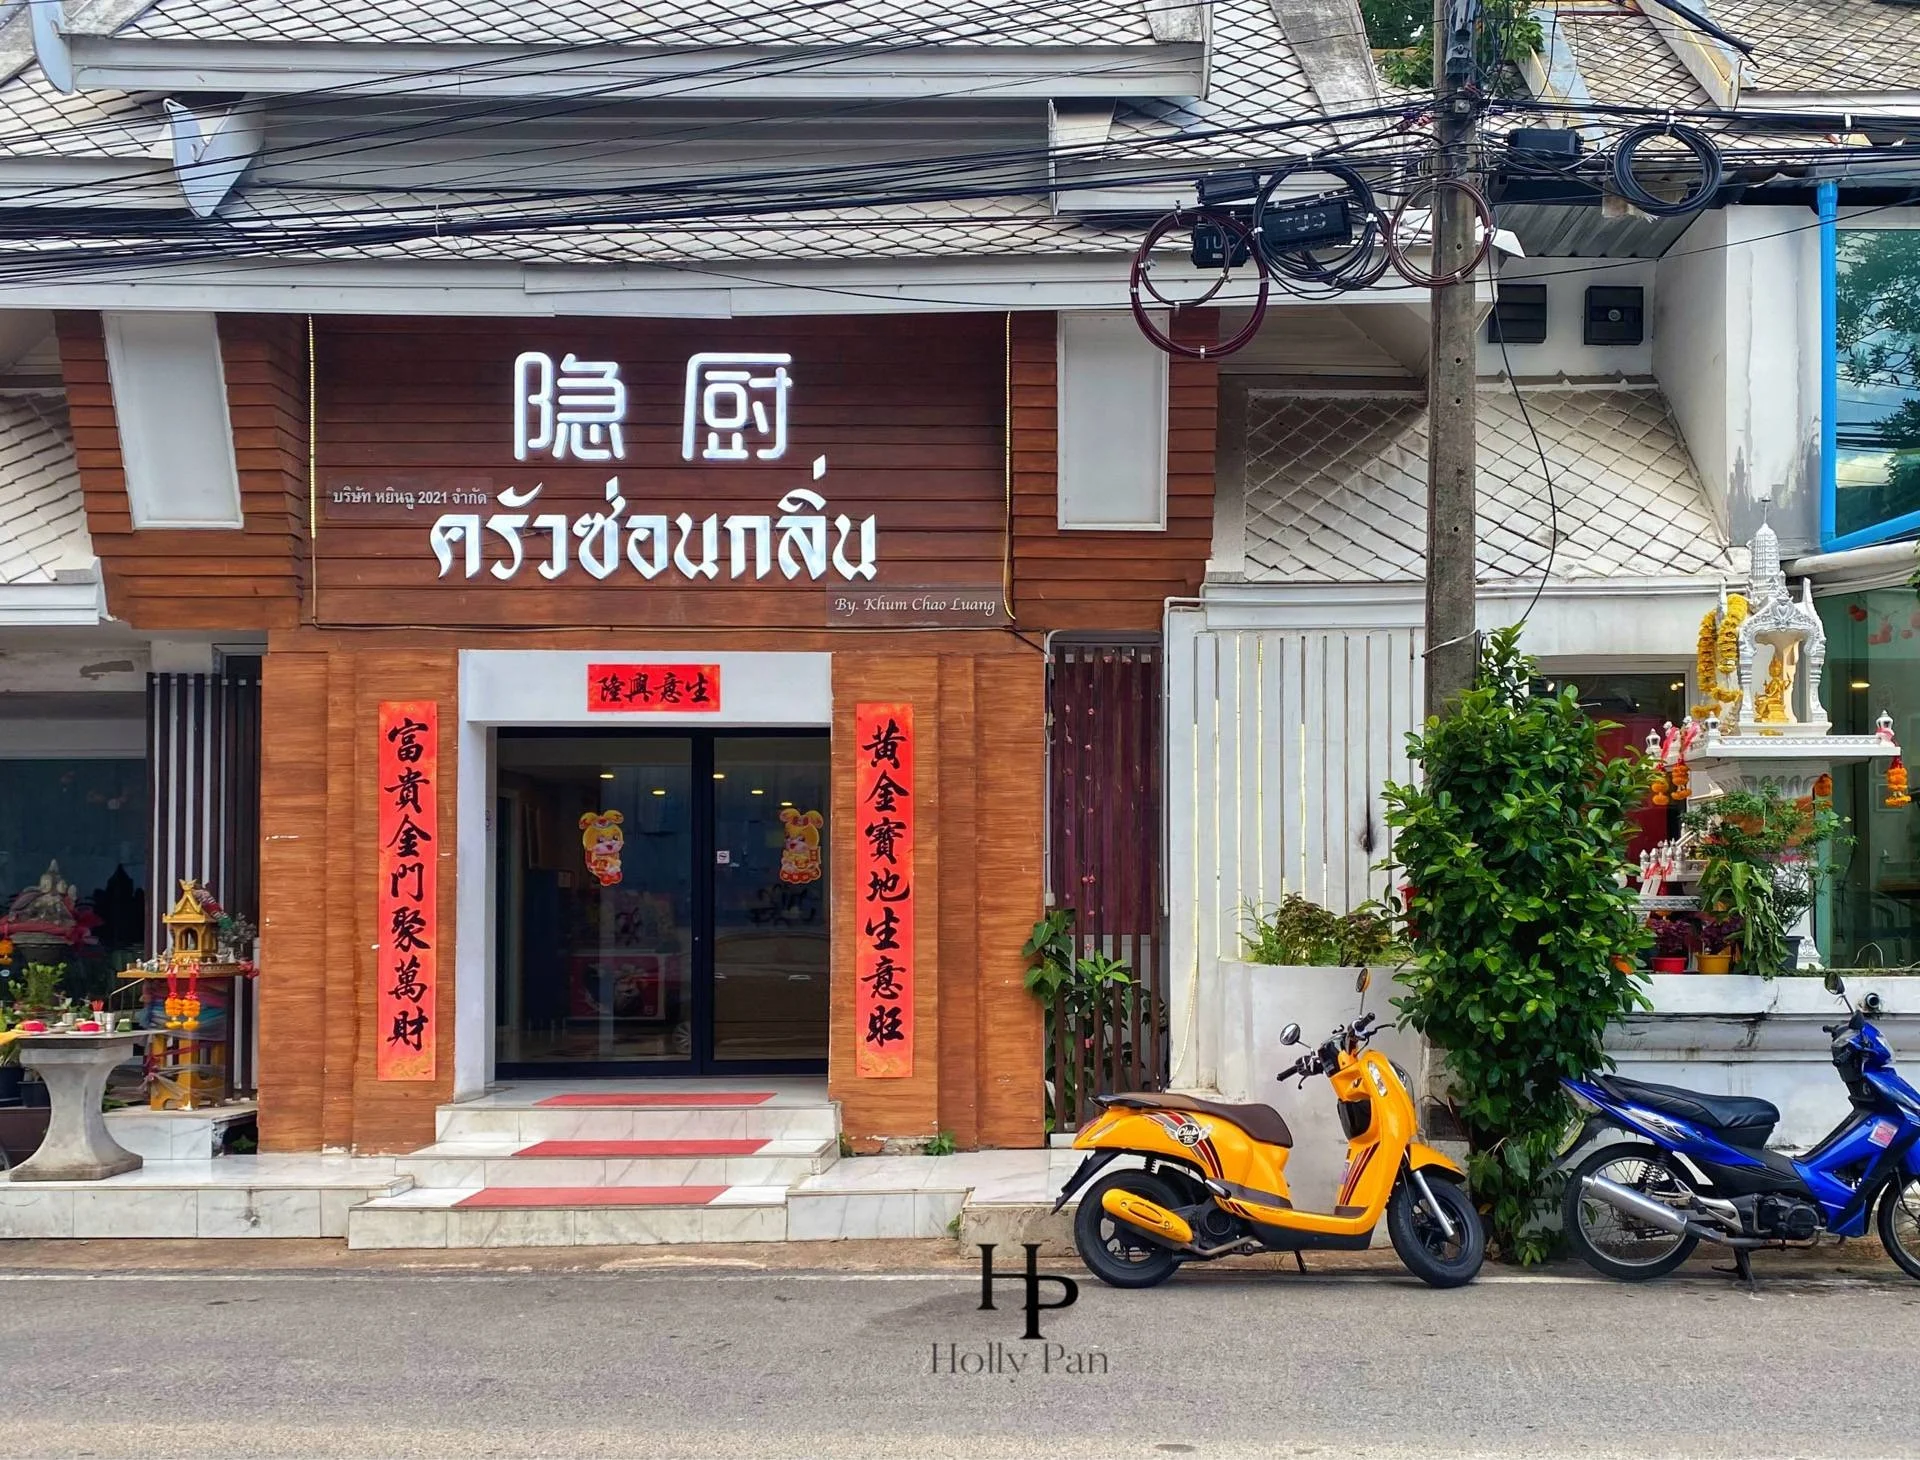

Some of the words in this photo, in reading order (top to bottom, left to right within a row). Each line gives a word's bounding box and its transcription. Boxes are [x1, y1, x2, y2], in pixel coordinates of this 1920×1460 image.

[333, 486, 371, 504] บริษัท
[418, 491, 447, 504] 2021
[452, 487, 487, 505] จำกัด
[429, 455, 878, 581] ครัวซ่อนกลิ่น
[835, 598, 859, 616] By.
[863, 595, 907, 611] Khum
[912, 595, 946, 611] Chao
[950, 597, 995, 616] Luang
[384, 717, 432, 1052] 富貴金門聚萬財
